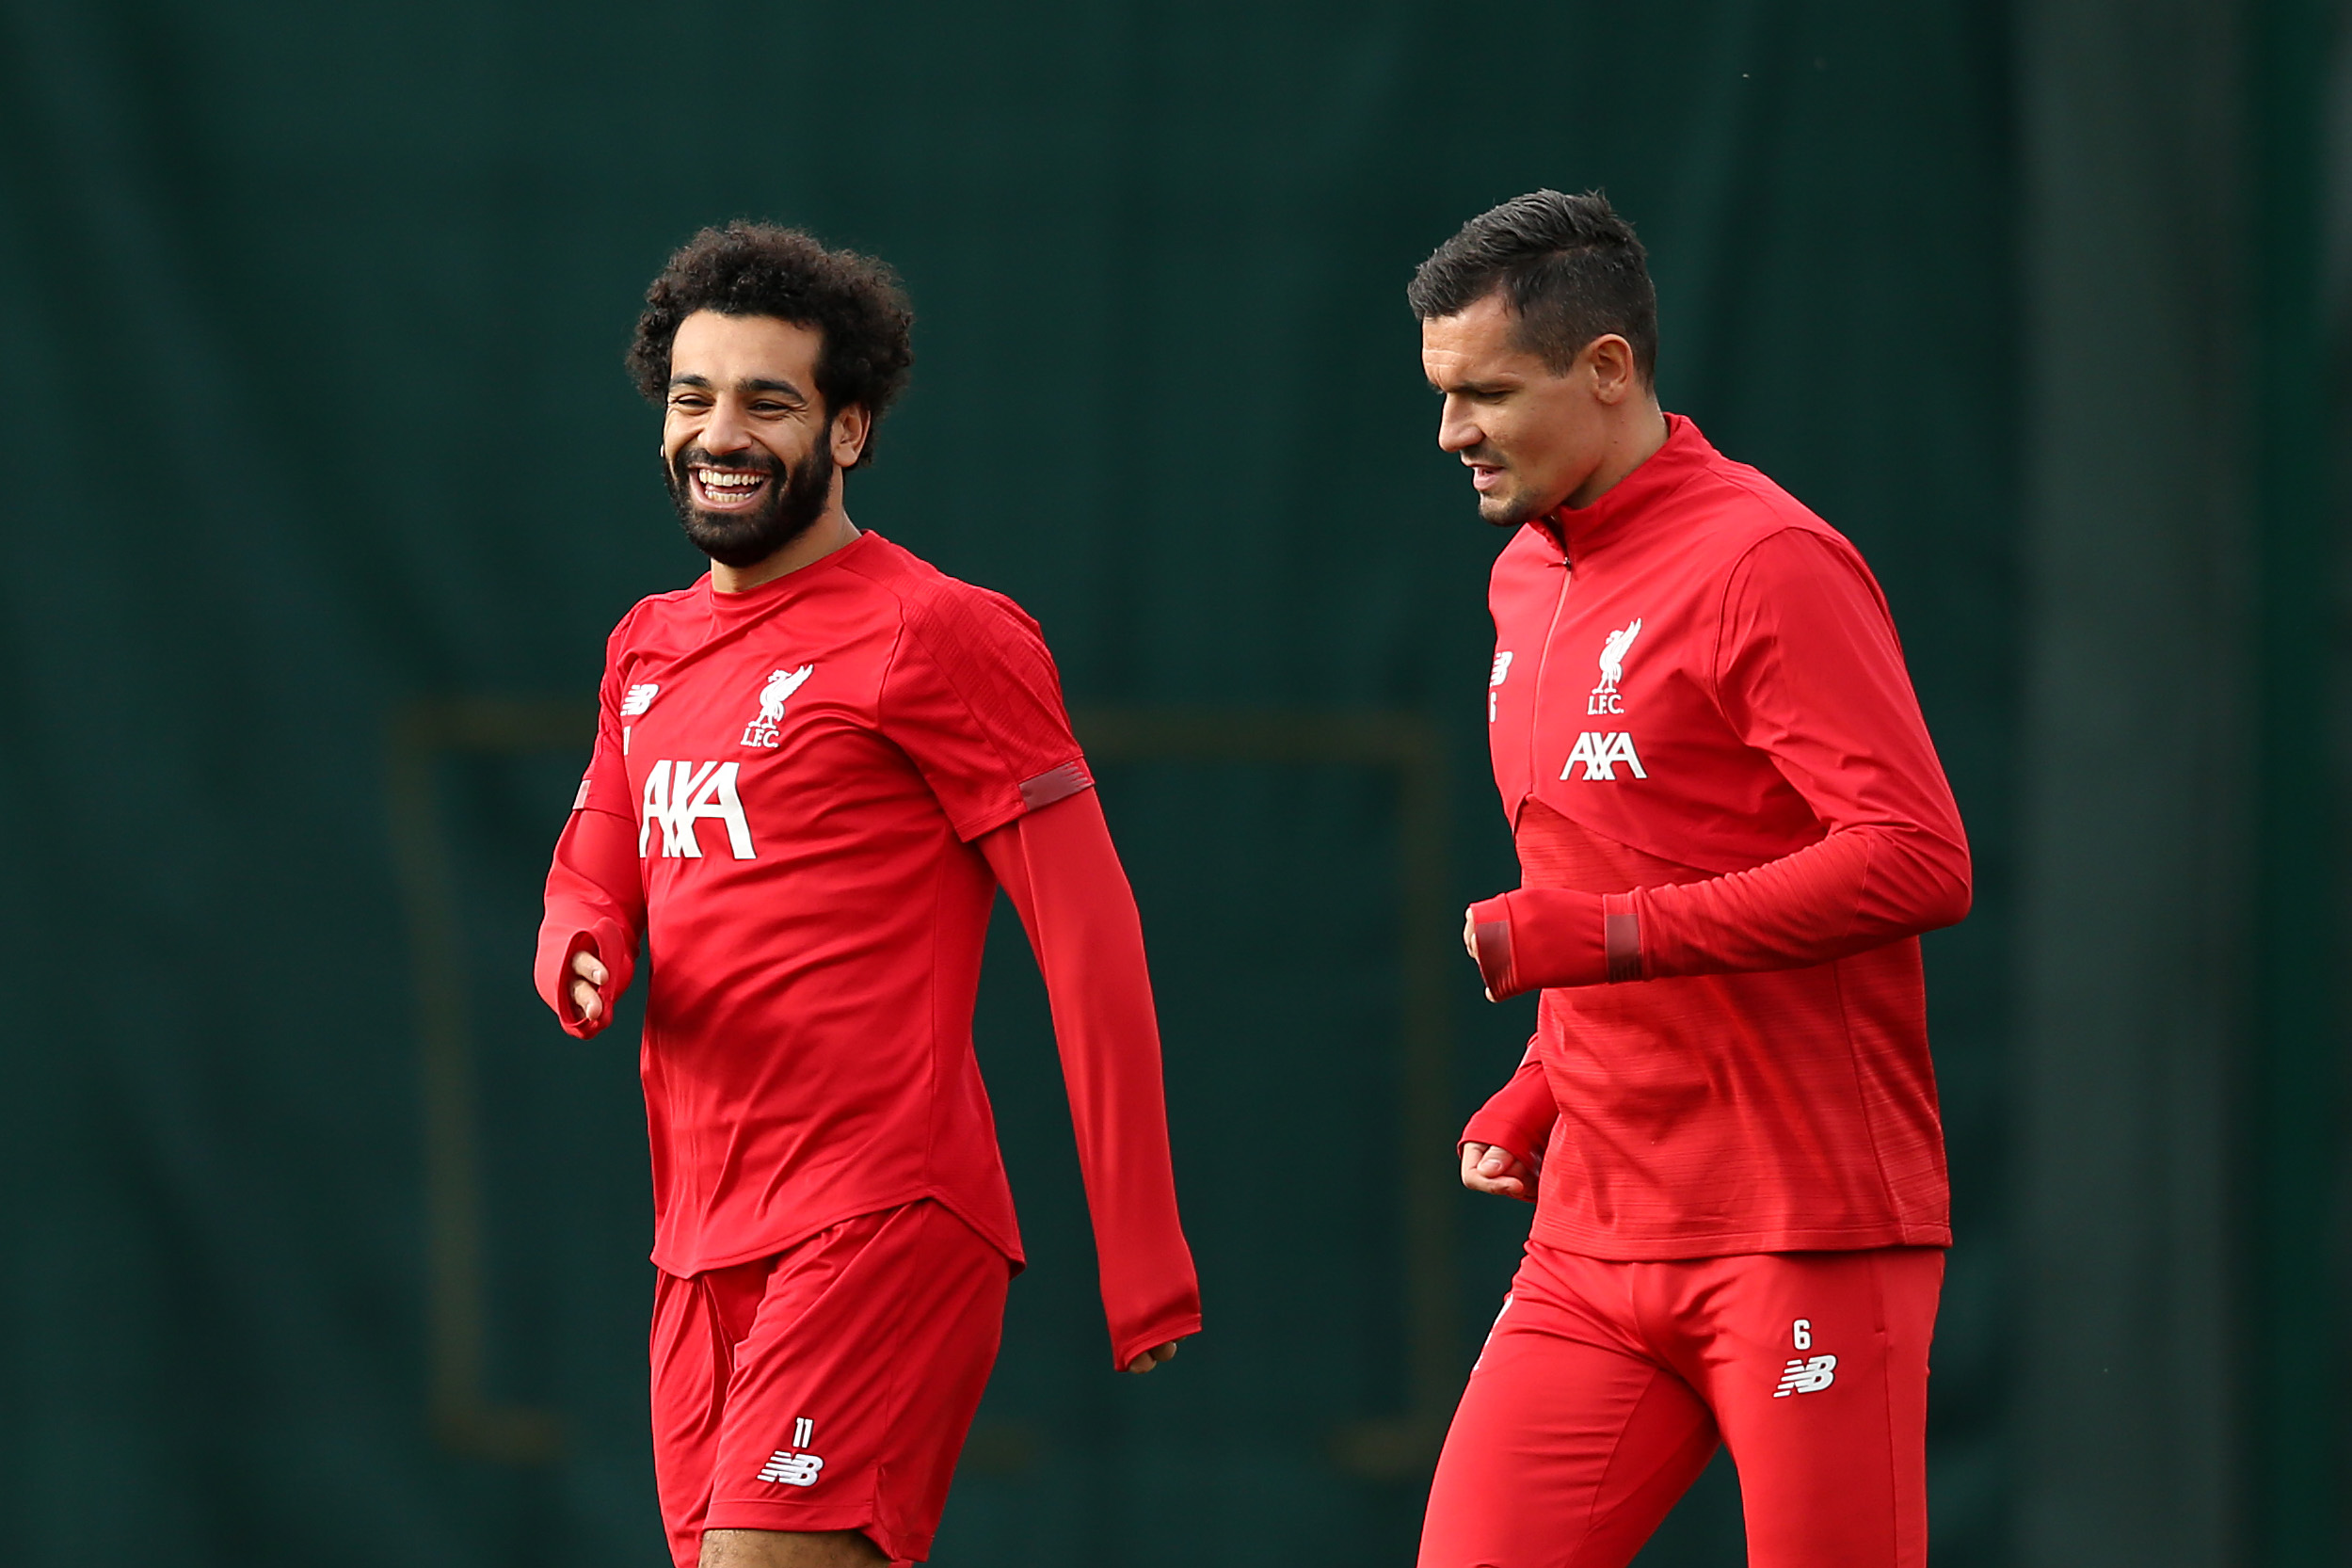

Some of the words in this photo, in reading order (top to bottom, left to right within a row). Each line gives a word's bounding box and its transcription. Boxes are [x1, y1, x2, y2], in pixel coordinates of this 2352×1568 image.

[1559, 731, 1647, 780] AXA
[638, 760, 757, 859] AXA
[1793, 1319, 1811, 1350] 6
[792, 1417, 813, 1448] 11
